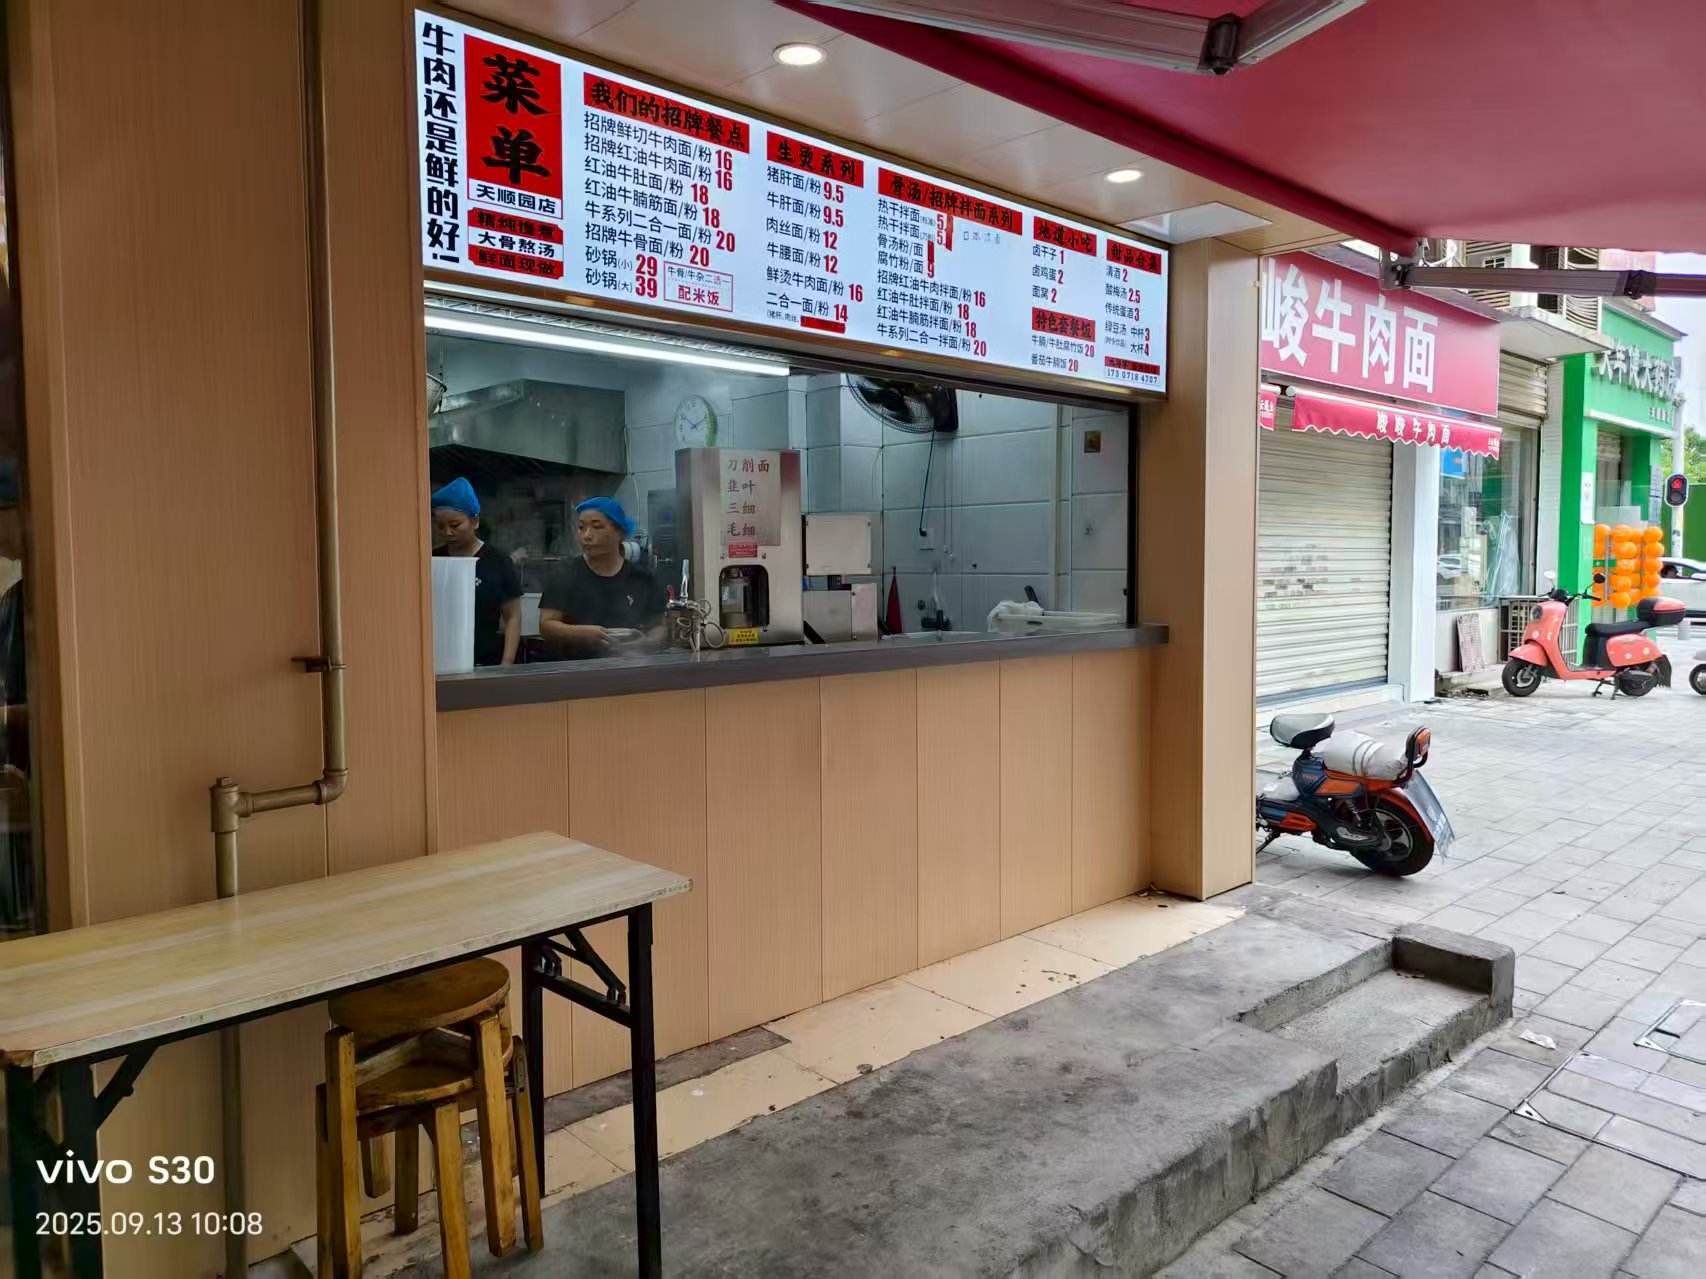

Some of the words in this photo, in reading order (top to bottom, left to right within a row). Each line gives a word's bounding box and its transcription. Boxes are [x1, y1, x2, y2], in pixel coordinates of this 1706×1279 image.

[480, 54, 552, 184] 菜单
[591, 80, 744, 148] 我们的招牌餐点
[584, 111, 712, 163] 招牌鲜切牛肉面/粉
[715, 150, 733, 171] 16
[584, 133, 712, 183] 招牌红油牛肉面/粉
[715, 170, 733, 191] 16
[584, 155, 683, 196] 红油牛肚面/粉
[691, 183, 709, 205] 18
[767, 165, 821, 195] 猪肝面/粉
[823, 181, 844, 204] 9.5
[476, 184, 555, 214] 天顺园店
[585, 178, 698, 221] 红油牛腩筋面/粉
[703, 207, 720, 228] 18
[767, 191, 821, 219] 牛肝面/粉
[823, 206, 844, 228] 9.5
[585, 201, 712, 245] 牛系列二合一面/粉
[716, 230, 735, 252] 20
[766, 217, 820, 243] 肉丝面/粉
[823, 231, 838, 250] 12
[478, 231, 555, 257] 大骨熬汤
[585, 222, 683, 260] 招牌牛骨面/粉
[689, 245, 709, 267] 20
[766, 241, 821, 268] 牛腰面/粉
[823, 255, 838, 274] 12
[878, 233, 923, 257] 骨汤粉/面
[1033, 244, 1057, 261] 卤干子
[1060, 250, 1064, 264] 1
[635, 254, 657, 276] 29
[878, 251, 923, 274] 腐竹粉/面
[928, 259, 934, 278] 9
[1032, 264, 1057, 281] 卤鸡蛋
[1058, 269, 1064, 284] 2
[1123, 269, 1128, 282] 2
[635, 275, 657, 298] 39
[678, 285, 719, 306] 配米饭
[766, 266, 844, 296] 鲜烫牛肉面/粉
[848, 284, 863, 303] 16
[878, 269, 972, 303] 招牌红油牛肉拌面/粉
[974, 290, 986, 308] 16
[1051, 288, 1057, 303] 2
[1128, 288, 1141, 303] 2.5
[766, 291, 829, 317] 二合一面/粉
[834, 304, 848, 322] 14
[877, 287, 953, 315] 红油牛肚拌面/粉
[958, 303, 970, 320] 18
[1134, 308, 1140, 321] 3
[877, 305, 962, 333] 红油牛腩筋拌面/粉
[965, 322, 977, 338] 18
[1036, 311, 1092, 339] 特色套餐饭
[1145, 328, 1150, 341] 3
[1261, 257, 1438, 394] 峻牛肉面
[877, 323, 971, 352] 牛系列二合一拌面/粉
[974, 340, 987, 357] 20
[1085, 344, 1095, 358] 20
[1144, 343, 1149, 356] 4
[1069, 359, 1079, 372] 20
[727, 458, 770, 473] 刀削面
[726, 502, 756, 515] 三细
[727, 522, 756, 537] 毛细
